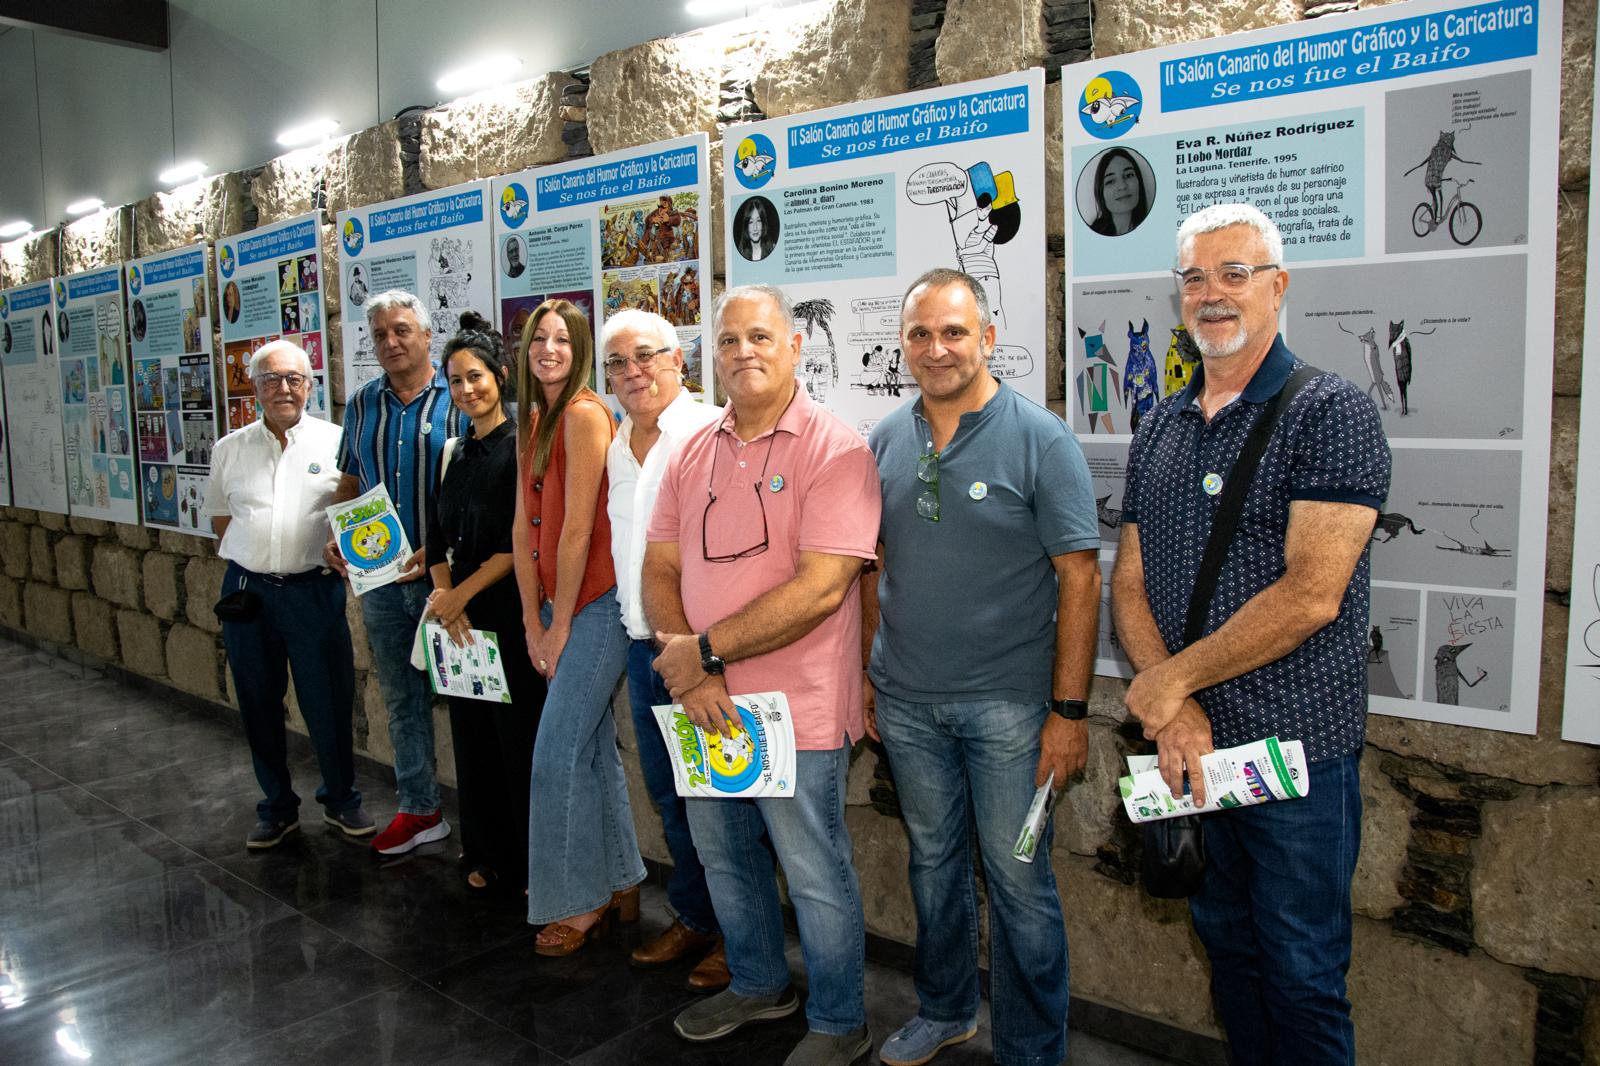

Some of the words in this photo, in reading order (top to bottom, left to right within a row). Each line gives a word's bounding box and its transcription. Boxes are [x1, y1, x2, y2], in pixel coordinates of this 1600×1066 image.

[1165, 64, 1174, 86] II
[1178, 58, 1213, 84] Salón
[1217, 49, 1269, 77] Canario
[1273, 43, 1293, 67] del
[1298, 38, 1347, 64] Humor
[1352, 26, 1406, 55] Gráfico
[1411, 26, 1420, 47] y
[1425, 19, 1439, 42] la
[1444, 5, 1532, 39] Caricatura
[1211, 82, 1241, 98] Se
[1248, 74, 1294, 93] nos
[1303, 66, 1346, 84] fue
[1356, 56, 1380, 75] el
[1390, 43, 1471, 71] Baifo
[791, 129, 797, 147] II
[800, 124, 823, 145] Salón
[826, 119, 859, 141] Canario
[862, 115, 875, 134] del
[878, 113, 909, 132] Humor
[912, 104, 947, 126] Gráfico
[950, 104, 956, 120] y
[959, 99, 968, 118] la
[970, 93, 1025, 116] Caricatura
[822, 144, 840, 158] Se
[846, 139, 876, 154] nos
[881, 134, 909, 148] fue
[915, 127, 932, 142] el
[937, 119, 988, 139] Baifo
[1176, 140, 1201, 150] Eva
[1206, 135, 1220, 146] R.
[1225, 130, 1271, 144] Núñez
[1276, 119, 1354, 138] Rodríguez
[1176, 154, 1185, 165] El
[1187, 151, 1212, 164] Lobo
[1215, 146, 1252, 160] Mordaz
[1176, 167, 1187, 175] La
[1228, 157, 1271, 169] Tenerife.
[1274, 153, 1297, 164] 1995
[544, 178, 560, 192] Salón
[562, 172, 584, 190] Canario
[586, 169, 596, 185] del
[597, 167, 617, 183] Humor
[620, 161, 643, 178] Gráfico
[645, 163, 649, 174] y
[651, 157, 657, 172] la
[658, 153, 696, 171] Caricatura
[1176, 177, 1218, 189] Ilustradora
[1221, 178, 1227, 188] y
[1229, 173, 1264, 184] viñetista
[1267, 170, 1277, 180] de
[1279, 168, 1306, 179] humor
[1310, 163, 1344, 176] satírico
[560, 192, 572, 203] Se
[576, 188, 596, 200] nos
[600, 184, 619, 197] fue
[622, 180, 633, 192] el
[638, 174, 670, 189] Baifo
[784, 187, 817, 198] Carolina
[820, 184, 849, 193] Bonino
[851, 177, 884, 189] Moreno
[1176, 194, 1191, 205] que
[1192, 193, 1202, 201] se
[1205, 189, 1236, 203] expresa
[1247, 184, 1274, 195] través
[1277, 181, 1288, 192] de
[1290, 182, 1301, 190] su
[1303, 176, 1347, 193] personaje
[374, 212, 386, 226] Salón
[387, 209, 403, 223] Canario
[404, 207, 412, 220] del
[412, 206, 427, 219] Humor
[428, 202, 445, 215] Gráfico
[445, 202, 449, 212] y
[450, 198, 455, 211] la
[455, 195, 481, 209] Caricatura
[794, 206, 815, 214] Palmas
[1255, 200, 1271, 208] con
[1274, 196, 1281, 206] el
[1284, 196, 1299, 210] que
[1302, 191, 1324, 205] logra
[1326, 192, 1343, 201] una
[1275, 209, 1299, 219] redes
[1302, 205, 1341, 217] sociales.
[385, 226, 395, 236] Se
[397, 224, 412, 234] nos
[414, 220, 428, 231] fue
[429, 216, 438, 226] el
[441, 212, 464, 225] Baifo
[1318, 218, 1340, 230] trata
[1342, 216, 1353, 226] de
[1299, 236, 1306, 244] a
[1309, 232, 1338, 243] través
[1340, 230, 1351, 241] de
[351, 497, 387, 522] SALÓN
[1442, 595, 1484, 611] VIVA
[1449, 609, 1473, 622] LA
[671, 711, 704, 767] SALÓN
[758, 727, 766, 737] EL
[758, 738, 768, 753] FUE
[761, 754, 770, 771] NOS
